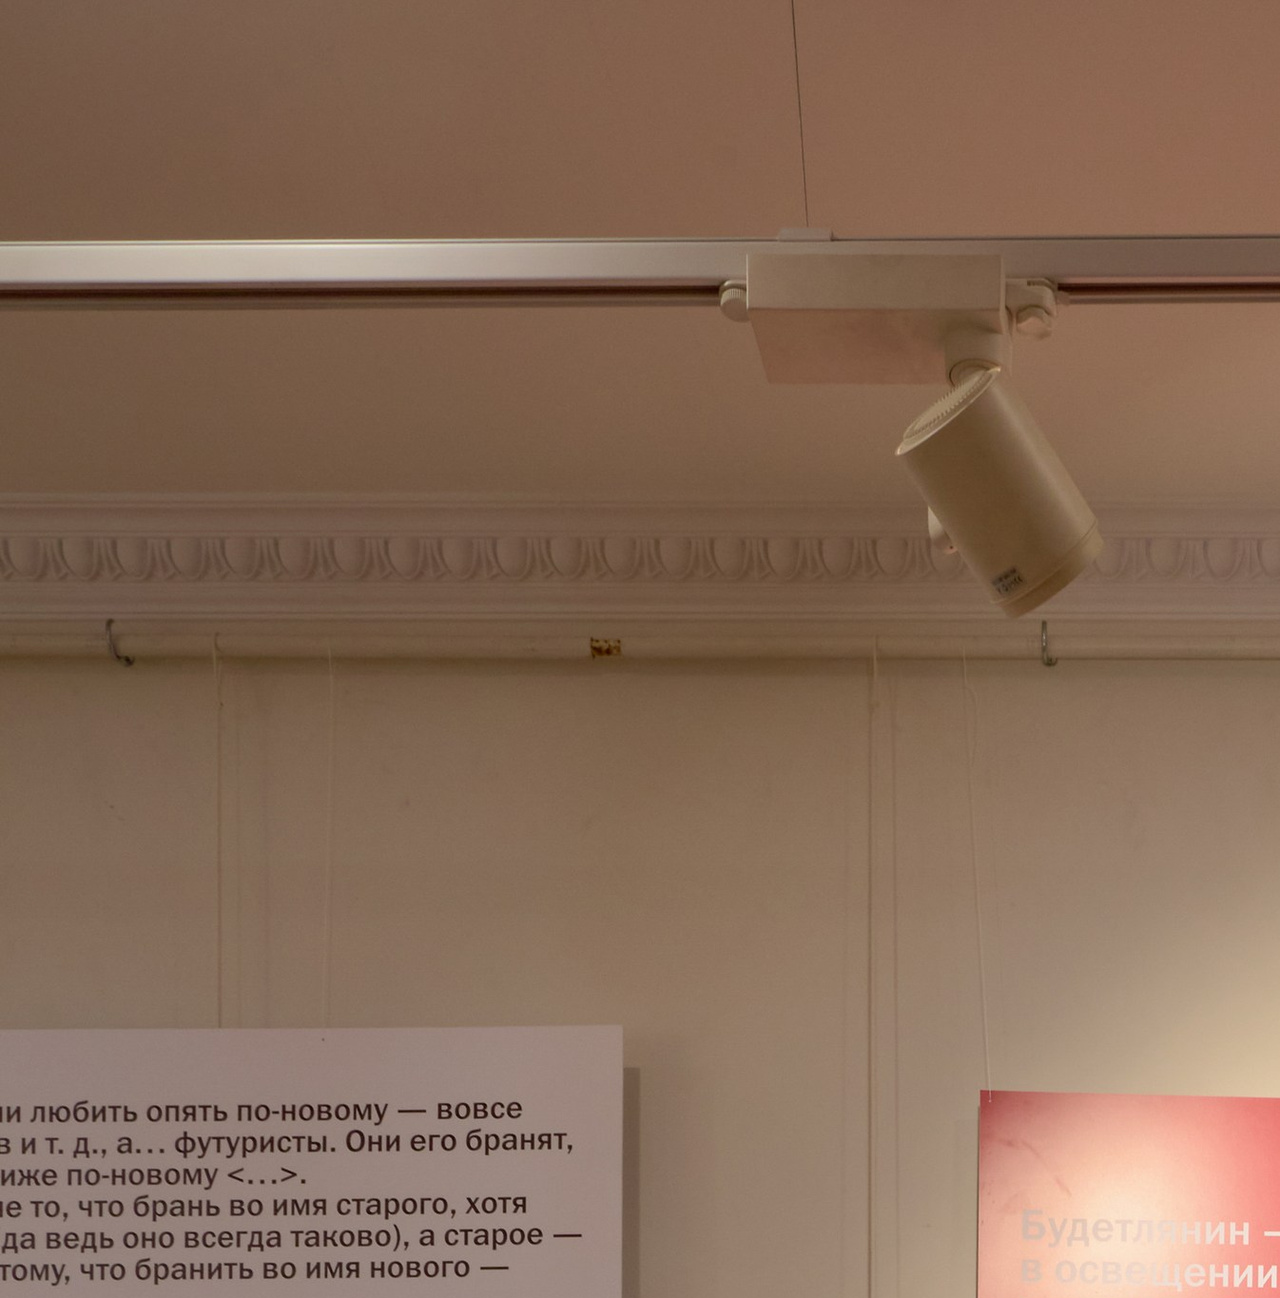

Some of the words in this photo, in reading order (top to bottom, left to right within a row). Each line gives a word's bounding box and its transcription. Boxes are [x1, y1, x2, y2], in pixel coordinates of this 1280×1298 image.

[30, 1100, 138, 1123] любить
[146, 1105, 228, 1122] опять
[237, 1103, 388, 1124] по-новому
[437, 1101, 523, 1120] вовсе
[1, 1232, 35, 1254] да
[46, 1232, 114, 1253] ведь
[123, 1231, 175, 1249] оно
[184, 1230, 281, 1252] всегда
[290, 1224, 409, 1252] таково),
[419, 1229, 435, 1246] а
[444, 1228, 543, 1251] старое
[1022, 1209, 1250, 1248] Будетлянин
[0, 1264, 70, 1286] тому,
[80, 1263, 126, 1281] что
[135, 1258, 254, 1285] бранить
[263, 1262, 296, 1279] во
[306, 1261, 360, 1279] имя
[370, 1260, 470, 1278] нового
[1021, 1259, 1043, 1284] в
[1055, 1260, 1278, 1292] освещении
